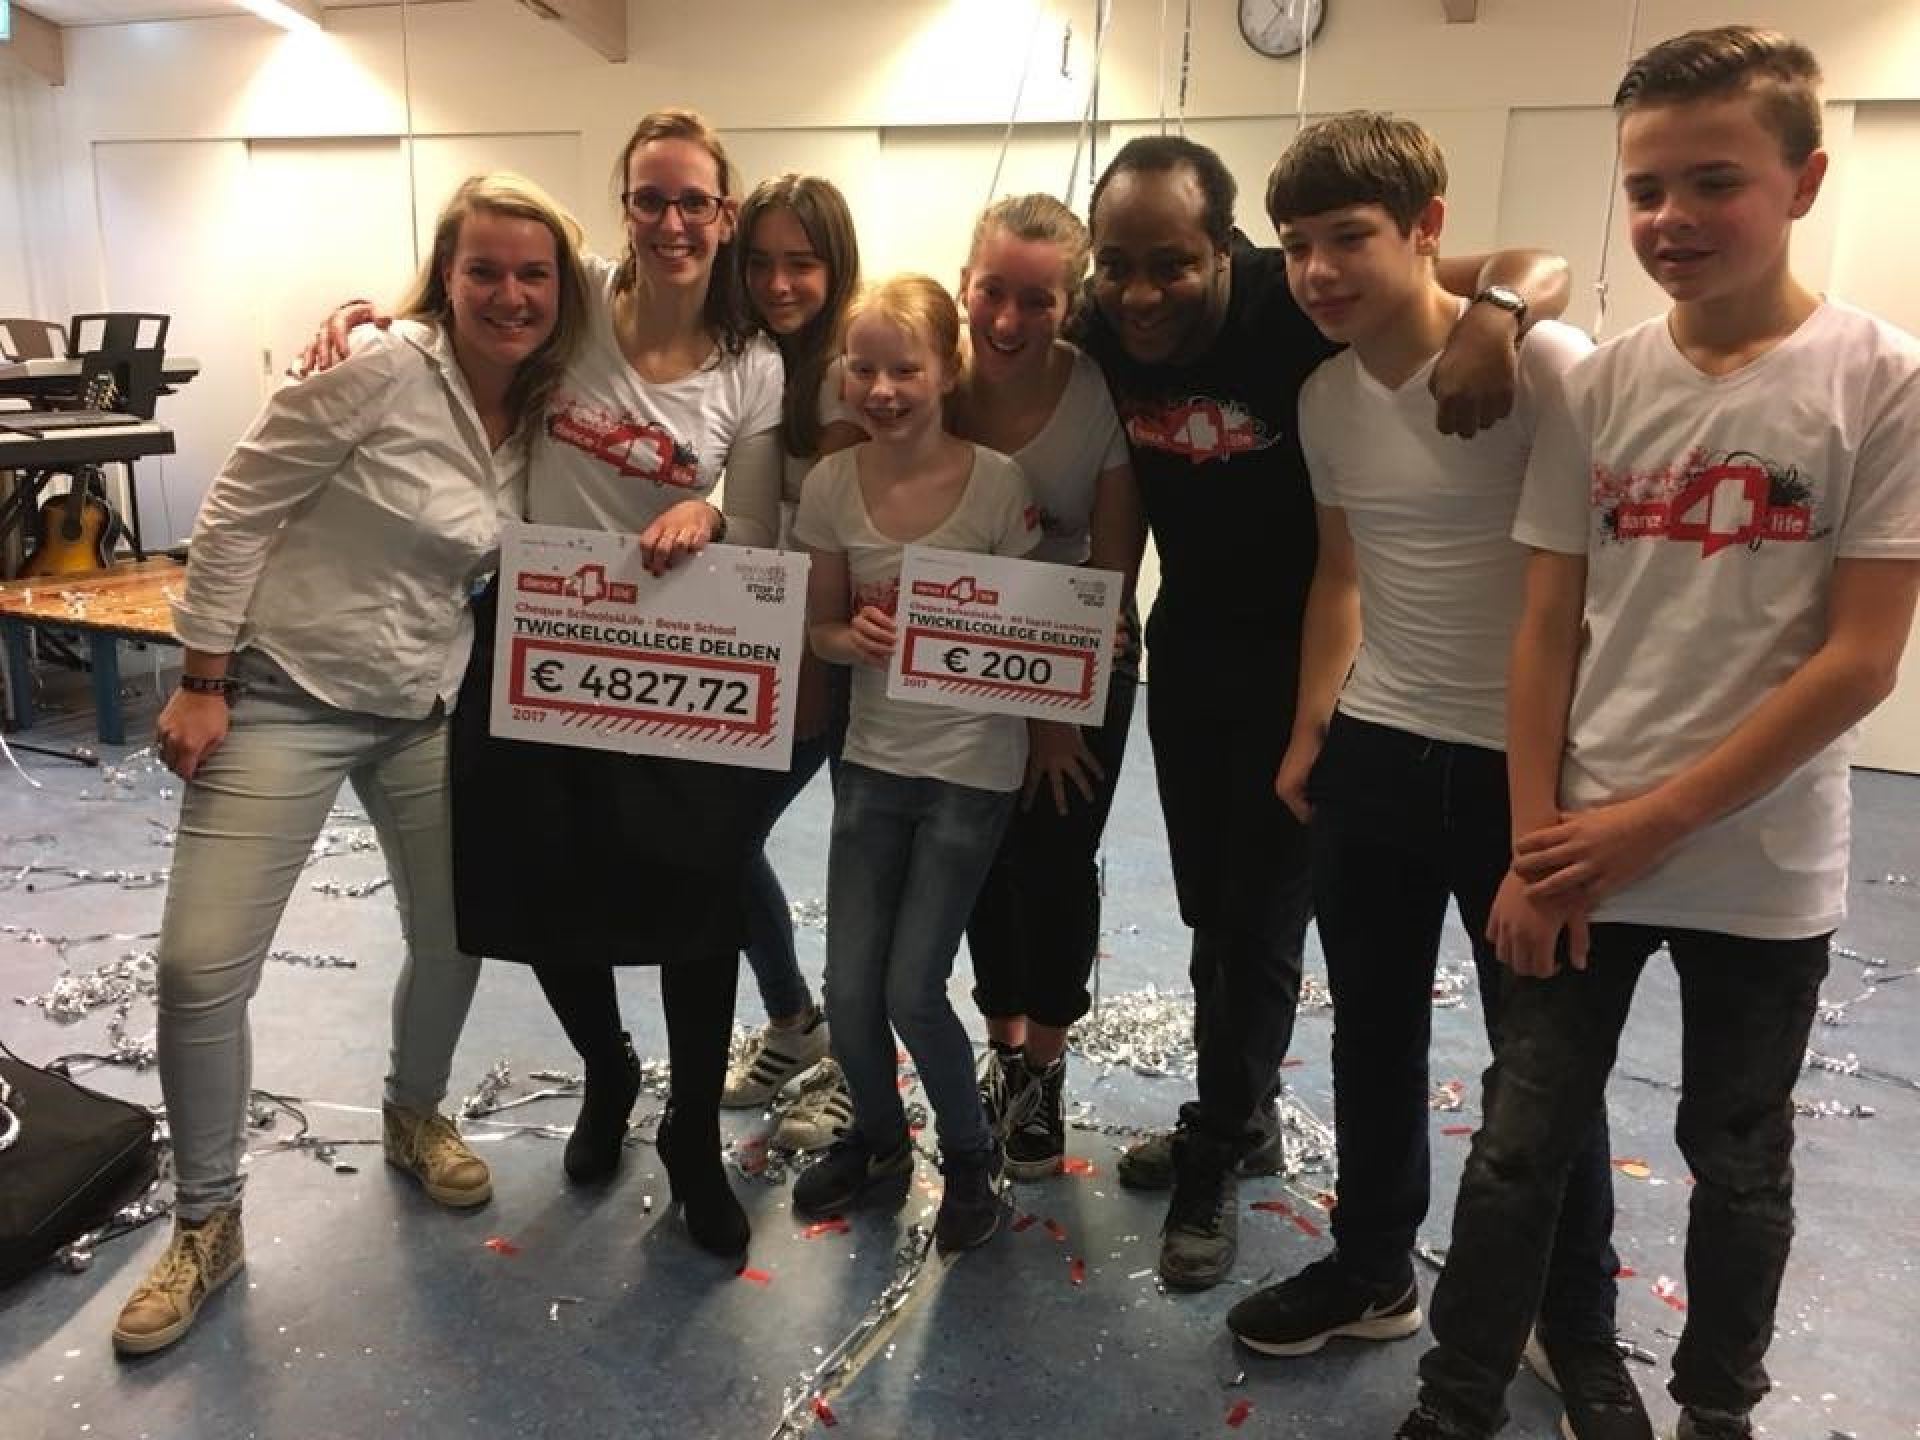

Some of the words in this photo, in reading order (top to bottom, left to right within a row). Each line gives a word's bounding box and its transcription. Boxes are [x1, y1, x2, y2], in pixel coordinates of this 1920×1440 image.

[1772, 512, 1803, 532] life
[515, 601, 563, 617] Cheque
[513, 617, 695, 653] TWICKELCOLLEGE
[700, 638, 782, 662] DELDEN
[907, 611, 1039, 641] TWICKELCOLLEGE
[1041, 629, 1102, 649] DELDEN
[943, 646, 971, 674] €
[980, 650, 1053, 686] 200
[530, 659, 565, 693] €
[578, 663, 749, 716] 4827,72
[512, 708, 547, 723] 2017
